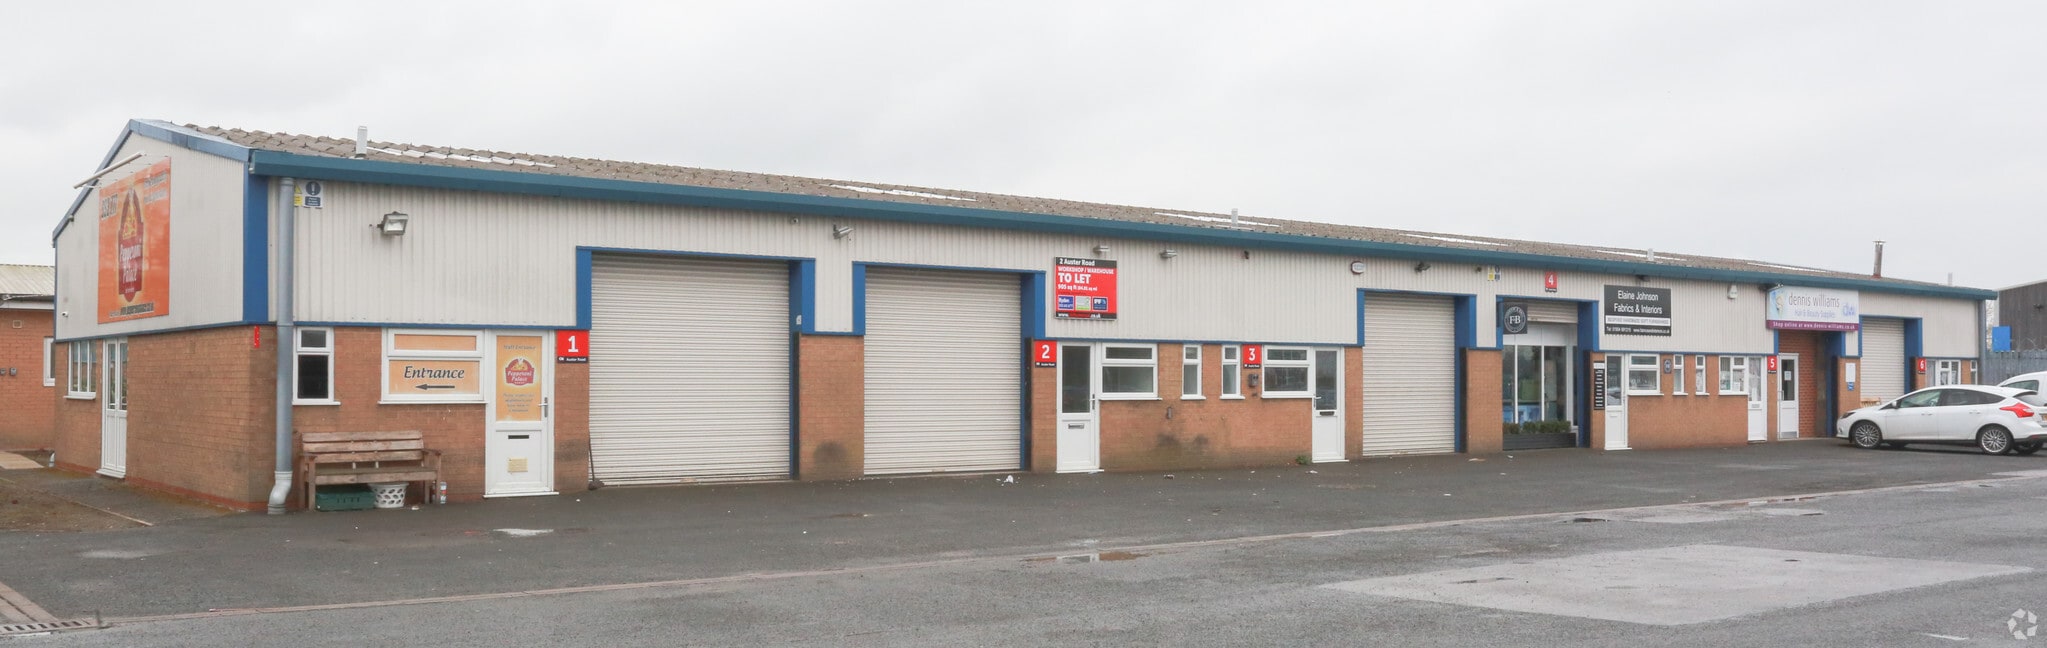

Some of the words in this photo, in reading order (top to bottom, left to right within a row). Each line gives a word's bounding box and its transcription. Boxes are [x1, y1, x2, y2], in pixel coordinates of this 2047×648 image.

[1058, 273, 1072, 283] TO
[1074, 274, 1091, 284] LET
[1549, 275, 1554, 285] 4
[1618, 290, 1634, 299] Elaine
[1636, 292, 1658, 301] Johnson
[1788, 292, 1810, 306] dennis
[1813, 294, 1840, 307] williams
[1614, 303, 1634, 312] Fabrics
[1635, 304, 1639, 312] &
[1641, 305, 1662, 314] Interiors
[1807, 310, 1819, 319] Beauty
[568, 336, 579, 352] 1
[1042, 345, 1050, 358] 2
[1249, 348, 1256, 361] 3
[1770, 358, 1775, 368] 5
[1920, 360, 1924, 369] 6
[404, 366, 465, 379] Entrance
